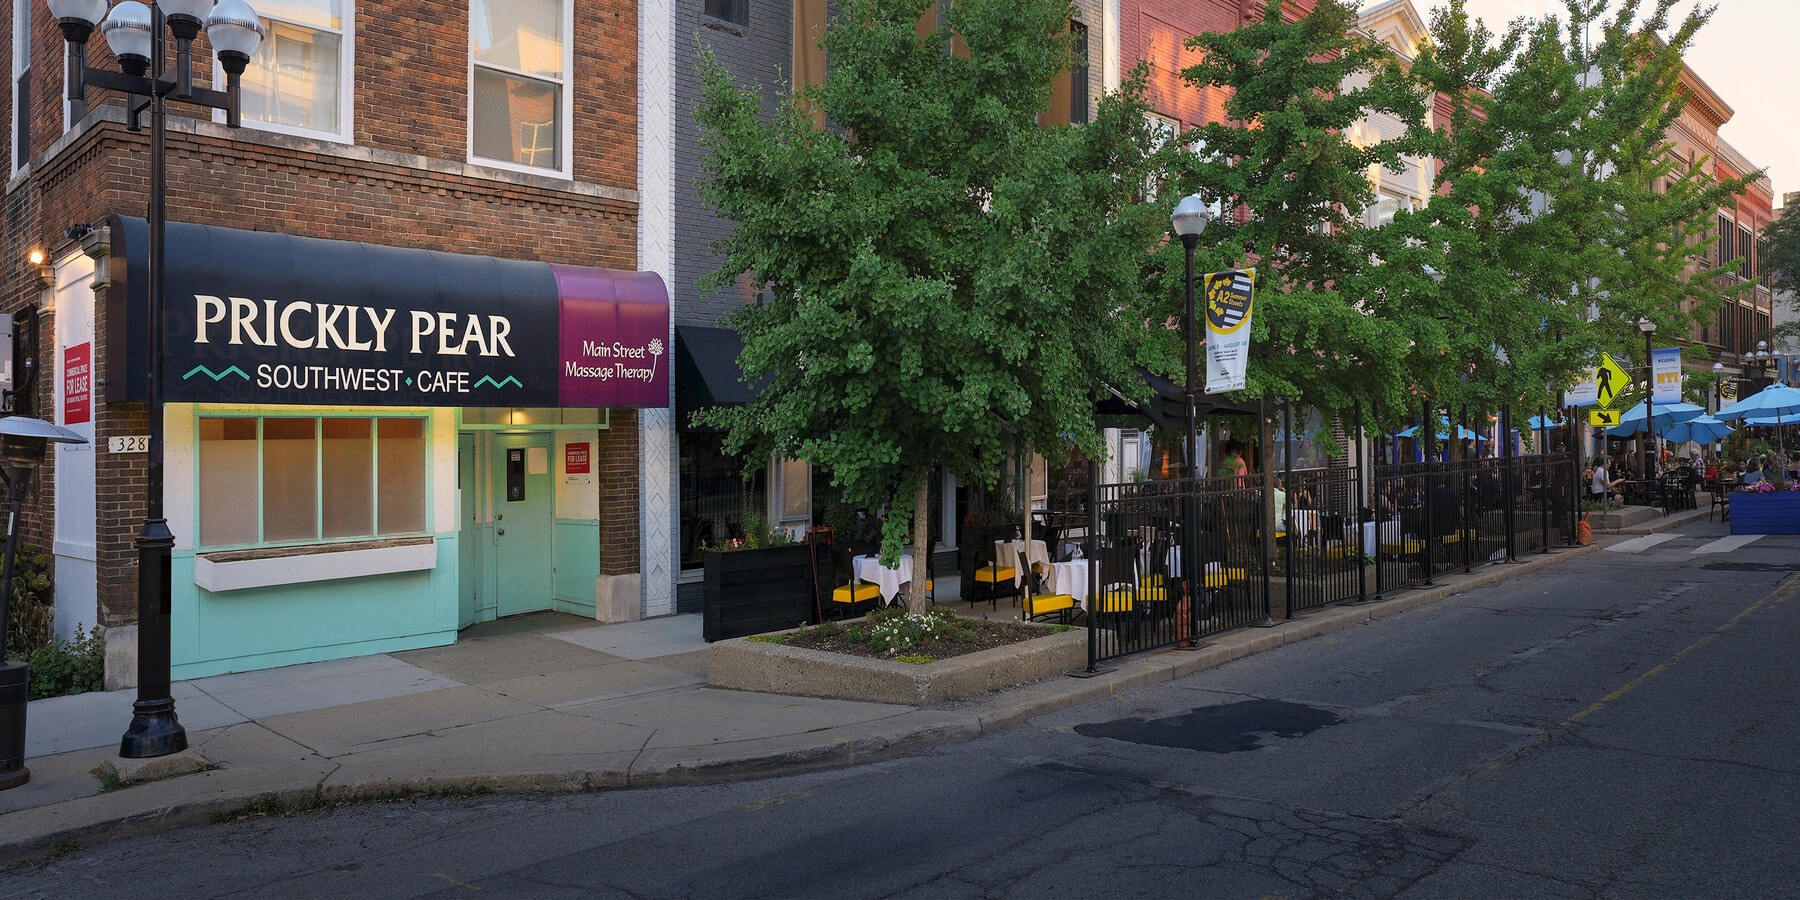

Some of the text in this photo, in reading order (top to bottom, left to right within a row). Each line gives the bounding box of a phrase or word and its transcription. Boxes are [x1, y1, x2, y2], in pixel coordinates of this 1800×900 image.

[1216, 290, 1230, 304] A2
[193, 294, 516, 357] PRICKLY PEAR
[582, 340, 646, 360] Main Street
[256, 363, 470, 393] SOUTHWEST CAFE
[565, 361, 656, 384] Massage Therapy
[1656, 372, 1678, 384] NTI
[66, 376, 88, 396] FOR LEASE
[117, 437, 146, 451] 328
